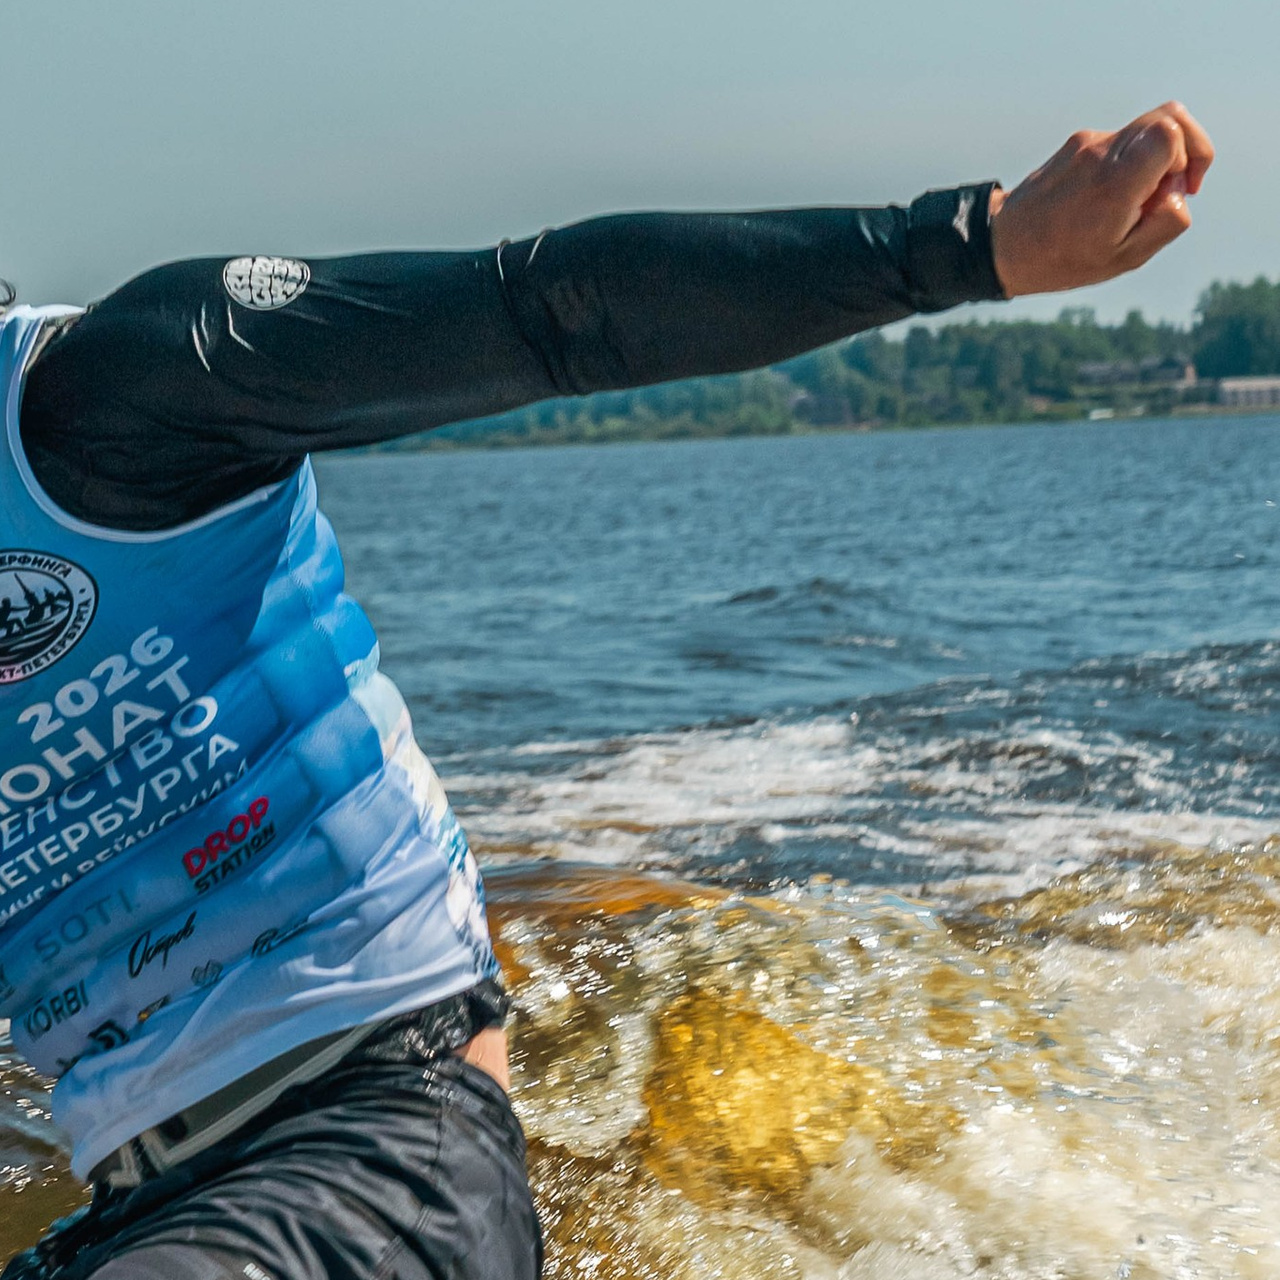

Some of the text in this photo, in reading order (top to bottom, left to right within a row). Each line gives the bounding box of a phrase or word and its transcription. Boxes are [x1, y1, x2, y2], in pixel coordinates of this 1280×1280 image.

[17, 625, 175, 745] 2026
[182, 795, 270, 880] DROP
[194, 821, 276, 896] STATION
